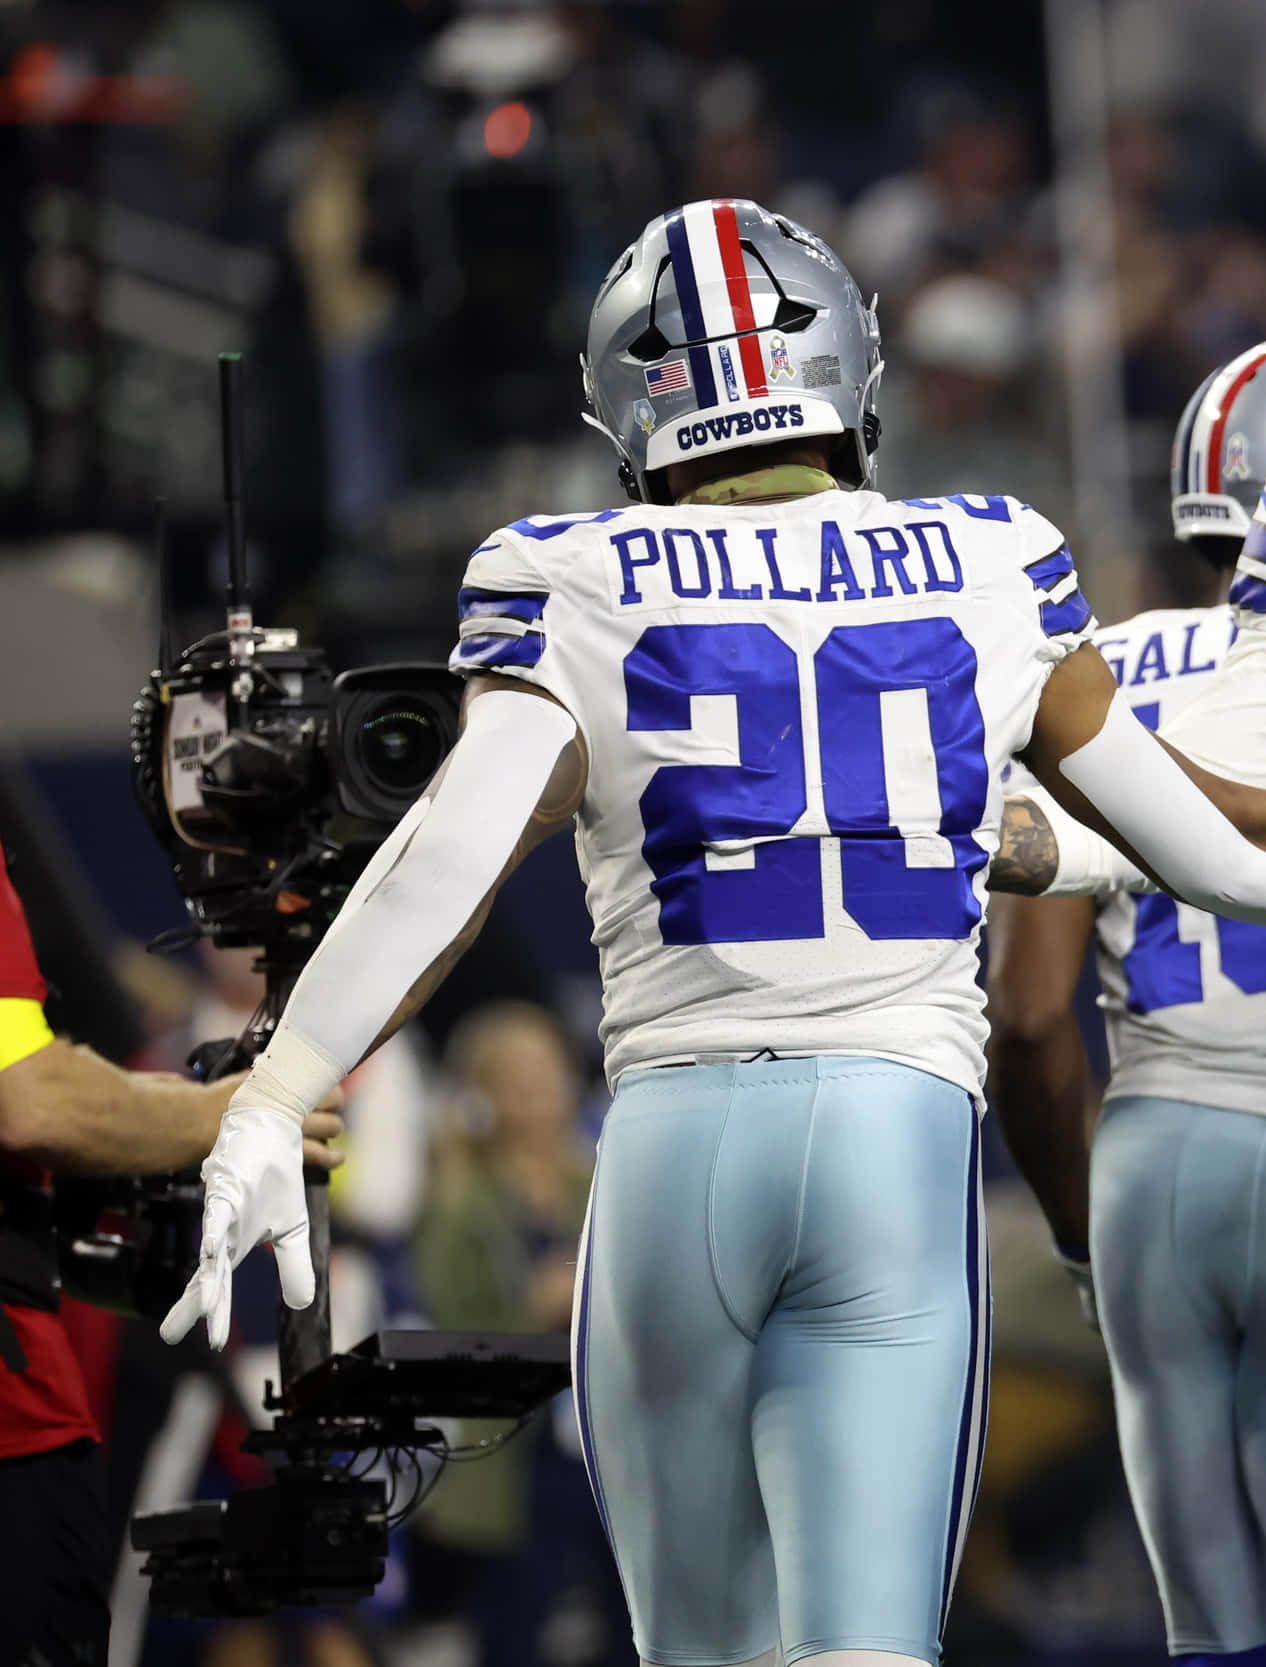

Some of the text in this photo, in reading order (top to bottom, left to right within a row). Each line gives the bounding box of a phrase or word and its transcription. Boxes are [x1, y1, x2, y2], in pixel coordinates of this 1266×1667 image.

[773, 355, 789, 369] NFL
[676, 404, 804, 451] COWBOYS
[609, 520, 965, 605] POLLARD
[1097, 616, 1240, 689] GAL
[622, 616, 990, 946] 20
